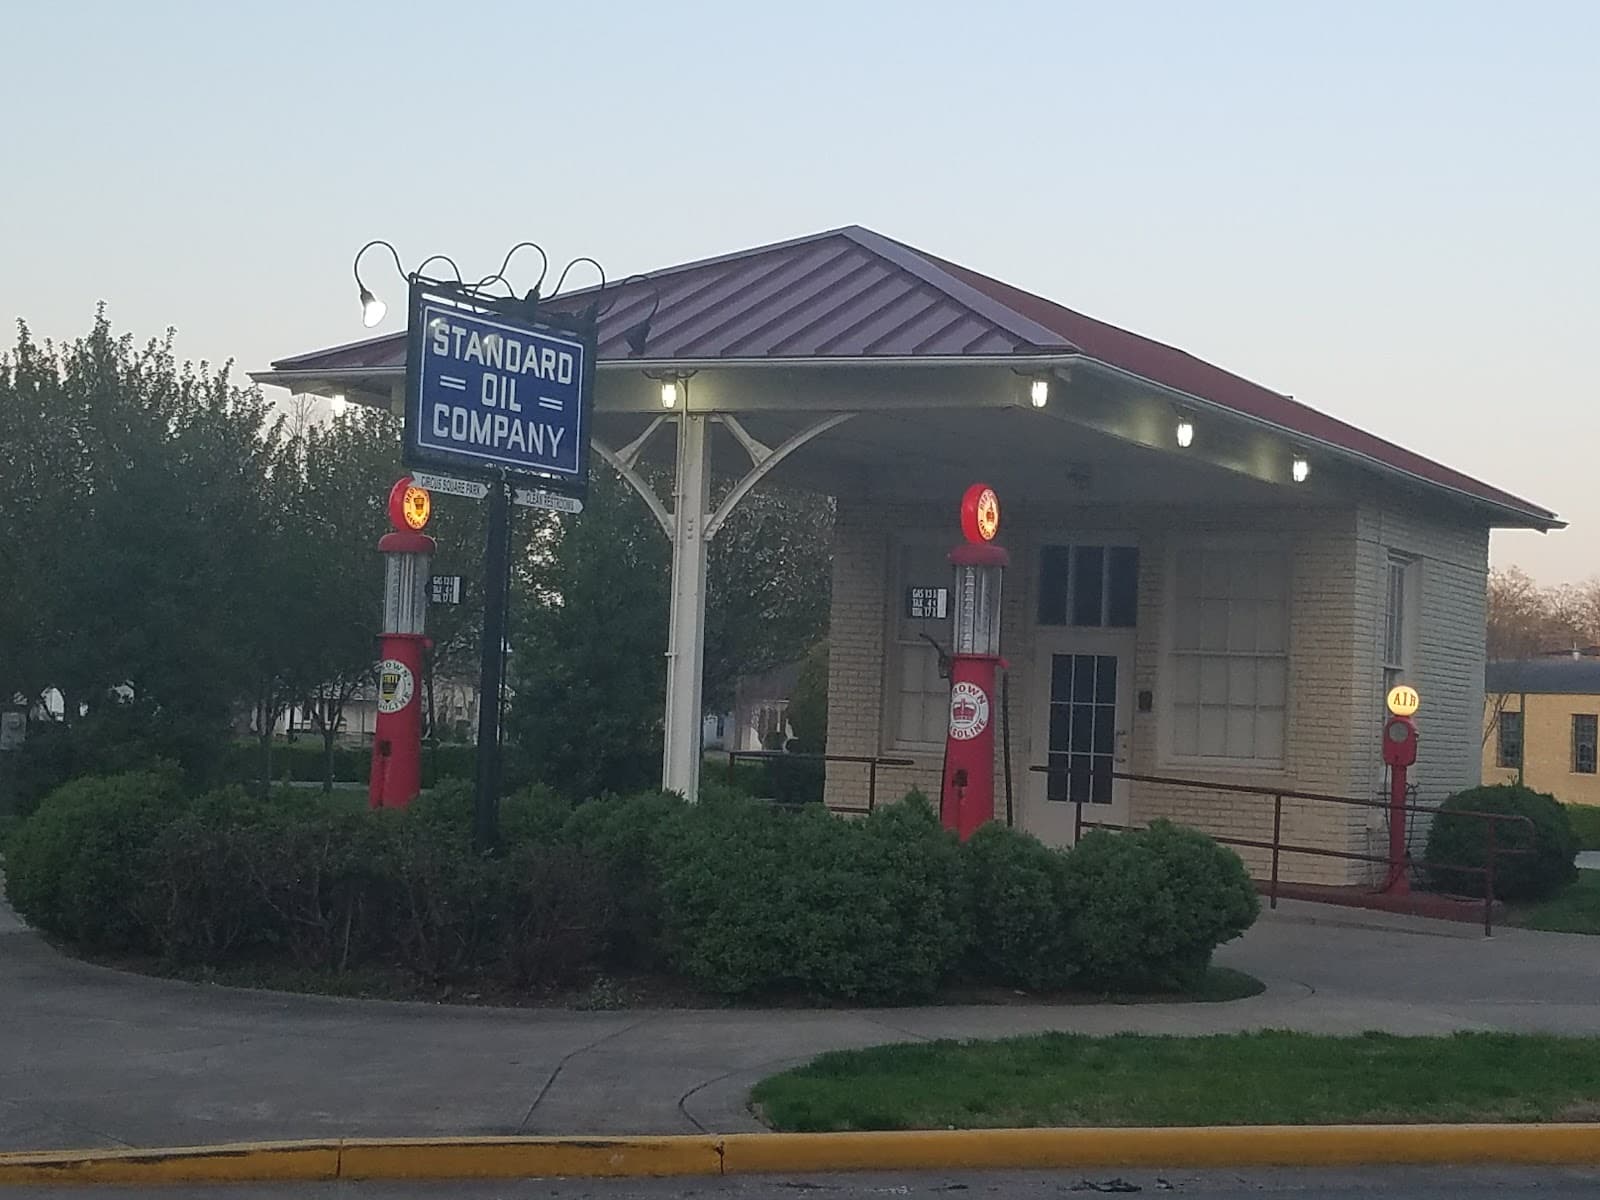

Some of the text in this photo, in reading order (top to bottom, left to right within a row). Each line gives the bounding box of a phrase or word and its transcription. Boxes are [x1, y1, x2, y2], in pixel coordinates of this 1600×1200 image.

[433, 323, 573, 385] STANDARD
[481, 372, 522, 412] OIL
[433, 403, 565, 458] COMPANY
[421, 475, 441, 490] CIRCUS
[442, 478, 465, 494] SQUARE
[466, 482, 481, 496] PARK
[1394, 691, 1416, 707] AIR
[949, 718, 986, 738] SOLINE
